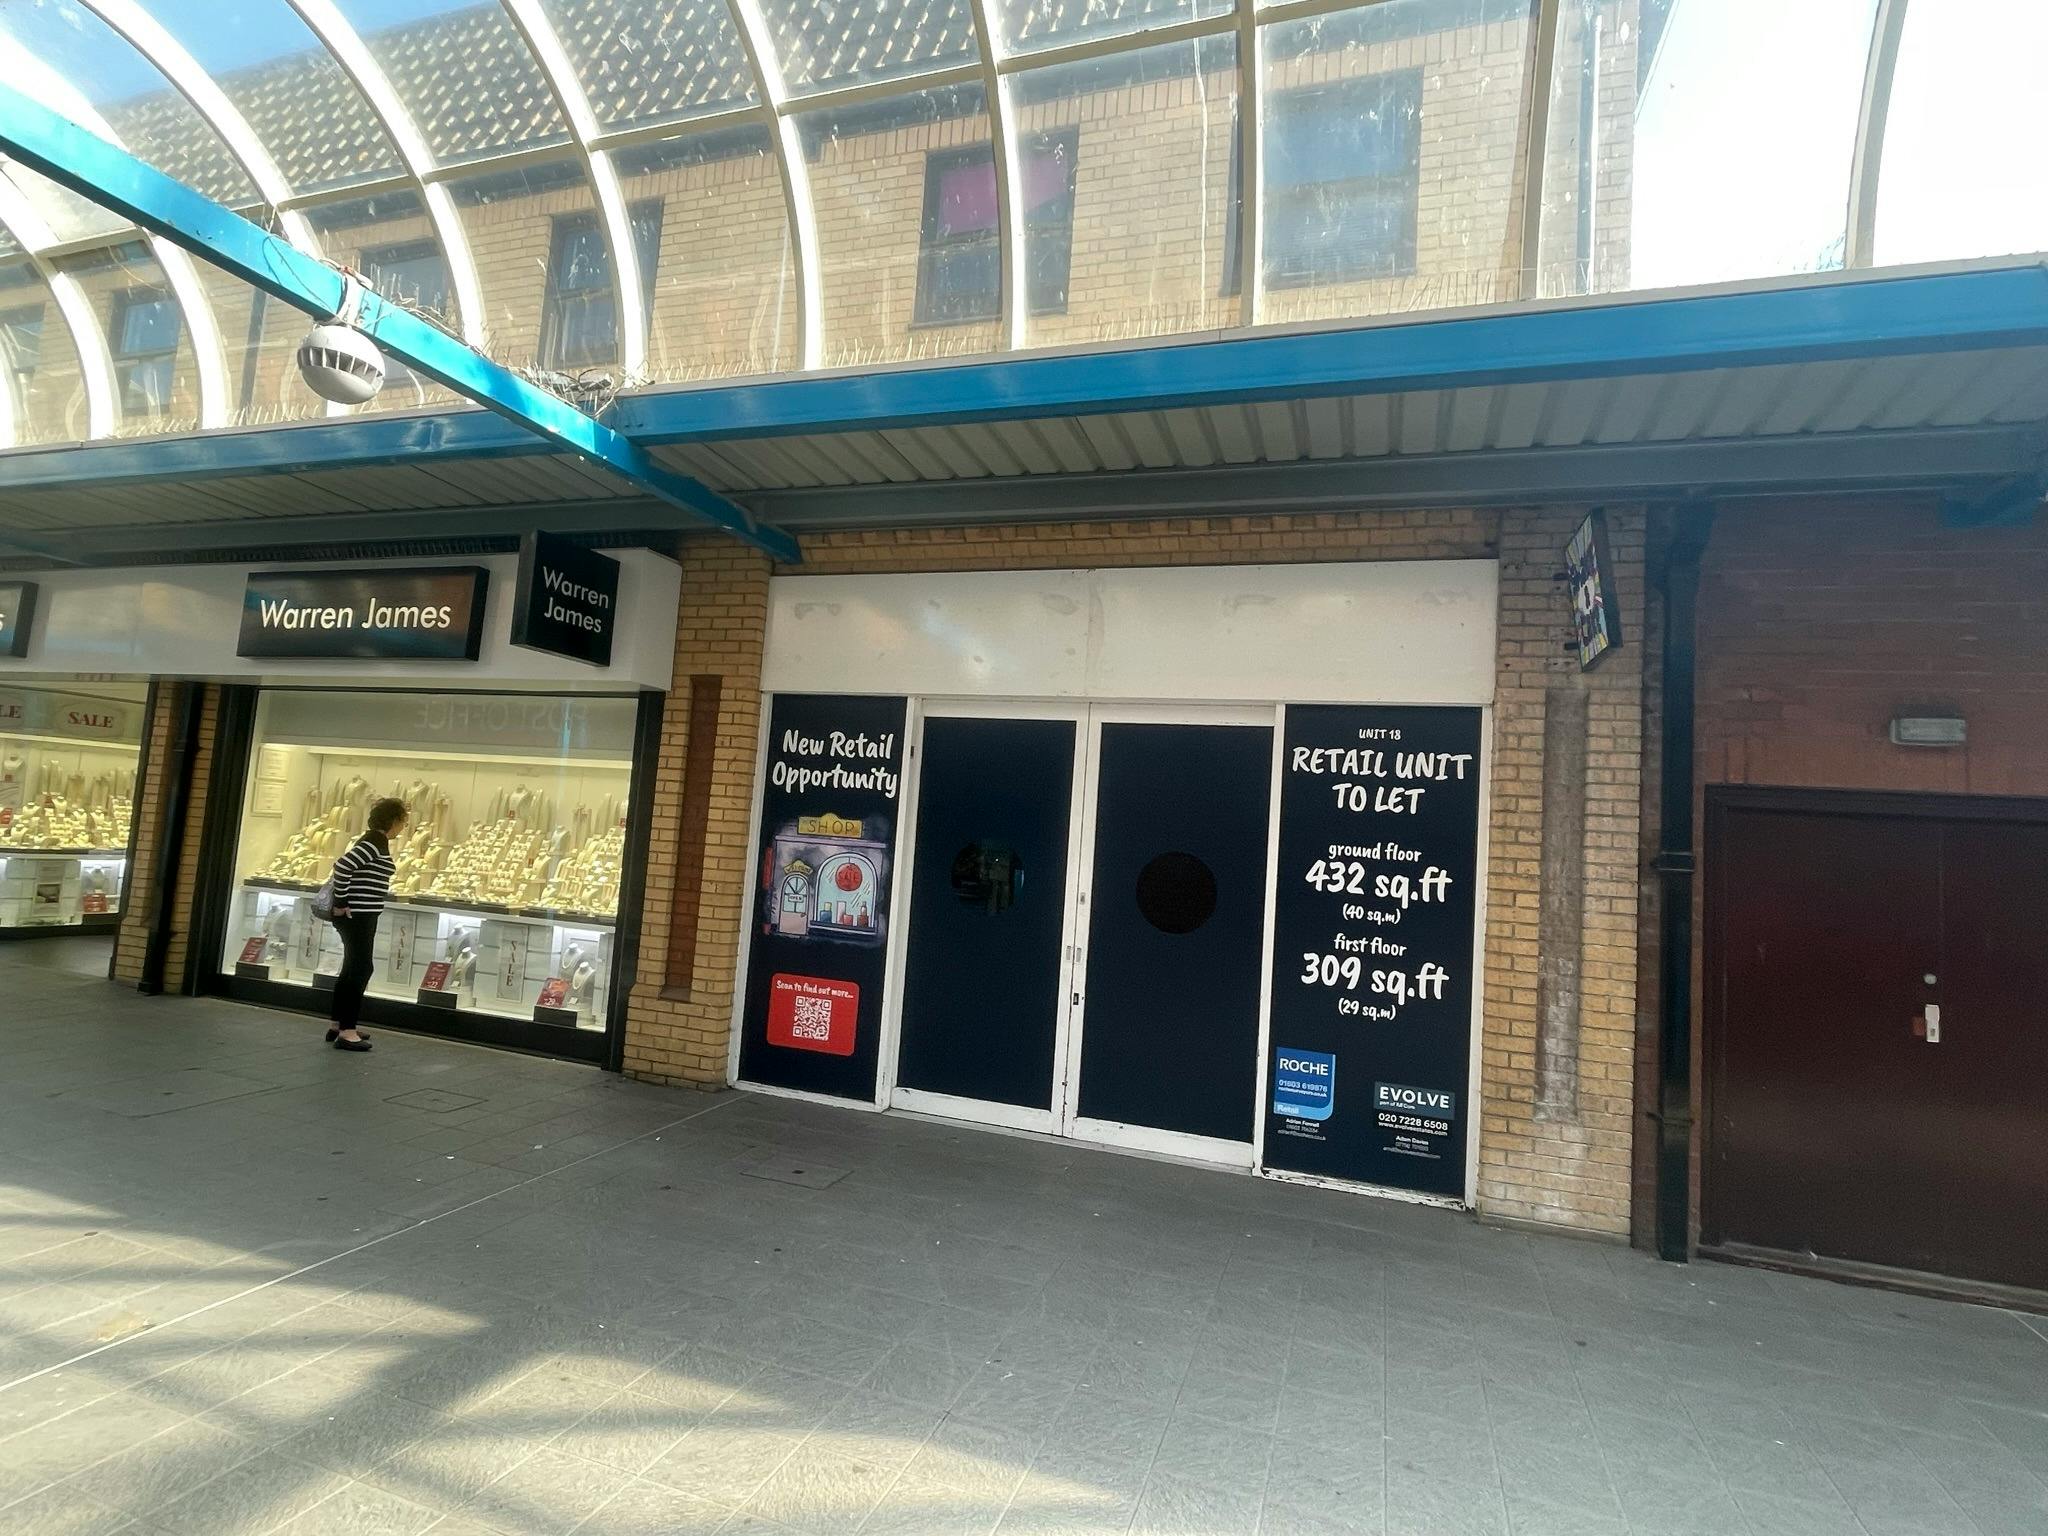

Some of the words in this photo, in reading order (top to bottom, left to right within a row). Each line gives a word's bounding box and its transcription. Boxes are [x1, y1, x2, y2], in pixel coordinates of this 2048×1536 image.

[543, 566, 609, 609] Warren
[260, 599, 353, 629] Warren
[361, 598, 451, 629] James
[544, 597, 602, 634] James
[67, 711, 114, 728] SALE
[783, 729, 824, 755] New
[830, 731, 894, 759] Retail
[1359, 729, 1387, 739] UNIT
[1389, 729, 1401, 740] 18
[1292, 747, 1387, 778] RETAIL
[1395, 752, 1472, 780] UNIT
[772, 761, 898, 798] Opportunity
[1332, 783, 1367, 812] TO
[1375, 786, 1425, 814] LET
[808, 820, 855, 834] SHOP
[1329, 842, 1380, 859] ground
[1385, 843, 1421, 862] floor
[1305, 860, 1365, 894] 432
[1374, 866, 1452, 909] sq.ft
[1343, 903, 1364, 920] (40
[1367, 909, 1400, 925] sq.m)
[1334, 933, 1368, 952] first
[1370, 937, 1407, 956] floor
[506, 940, 517, 986] SALE
[776, 980, 793, 990] Scan
[794, 983, 802, 991] to
[803, 983, 817, 993] find
[818, 987, 830, 995] out
[1301, 953, 1361, 989] 309
[1371, 962, 1449, 1005] sq.ft
[1338, 998, 1359, 1015] (29
[1362, 1005, 1396, 1021] sq.m)
[1280, 1058, 1328, 1076] ROCHE
[1380, 1086, 1449, 1108] EVOLVE
[1277, 1104, 1299, 1114] Retail
[1378, 1113, 1397, 1122] 020
[1399, 1116, 1421, 1126] 7228
[1424, 1120, 1448, 1130] 6508
